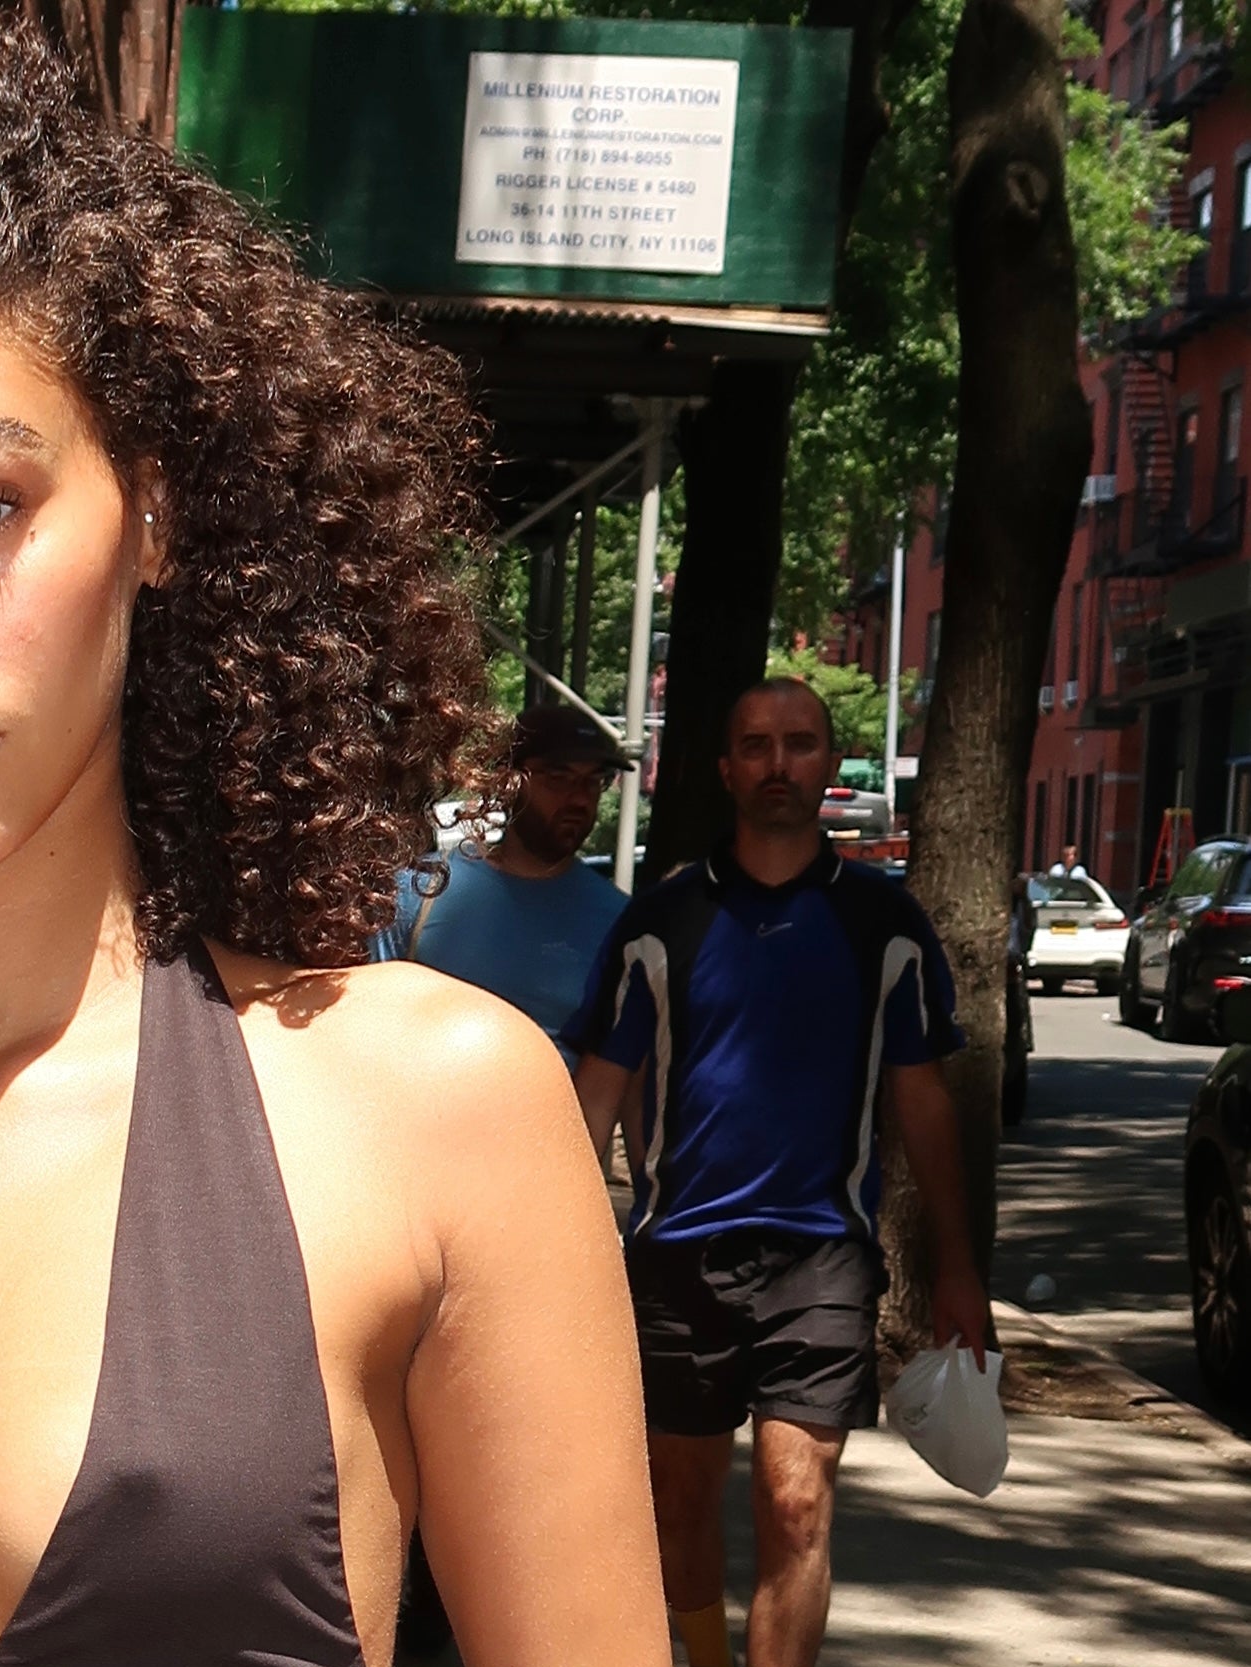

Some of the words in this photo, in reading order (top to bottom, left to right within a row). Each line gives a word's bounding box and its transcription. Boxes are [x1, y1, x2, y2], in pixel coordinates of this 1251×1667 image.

[483, 82, 584, 99] MILLENIUM
[588, 86, 721, 104] RESTORATION
[572, 107, 629, 123] CORP.
[556, 149, 596, 165] (718)
[600, 150, 673, 165] 894-8055
[495, 174, 561, 188] RIGGER
[566, 176, 638, 192] LICENSE
[658, 180, 696, 194] 5480
[510, 203, 554, 218] 36-14
[562, 205, 602, 219] 11TH
[609, 206, 676, 222] STREET
[465, 229, 514, 244] LONG
[521, 231, 584, 247] ISLAND
[640, 234, 663, 250] NY
[670, 236, 717, 252] 11106
